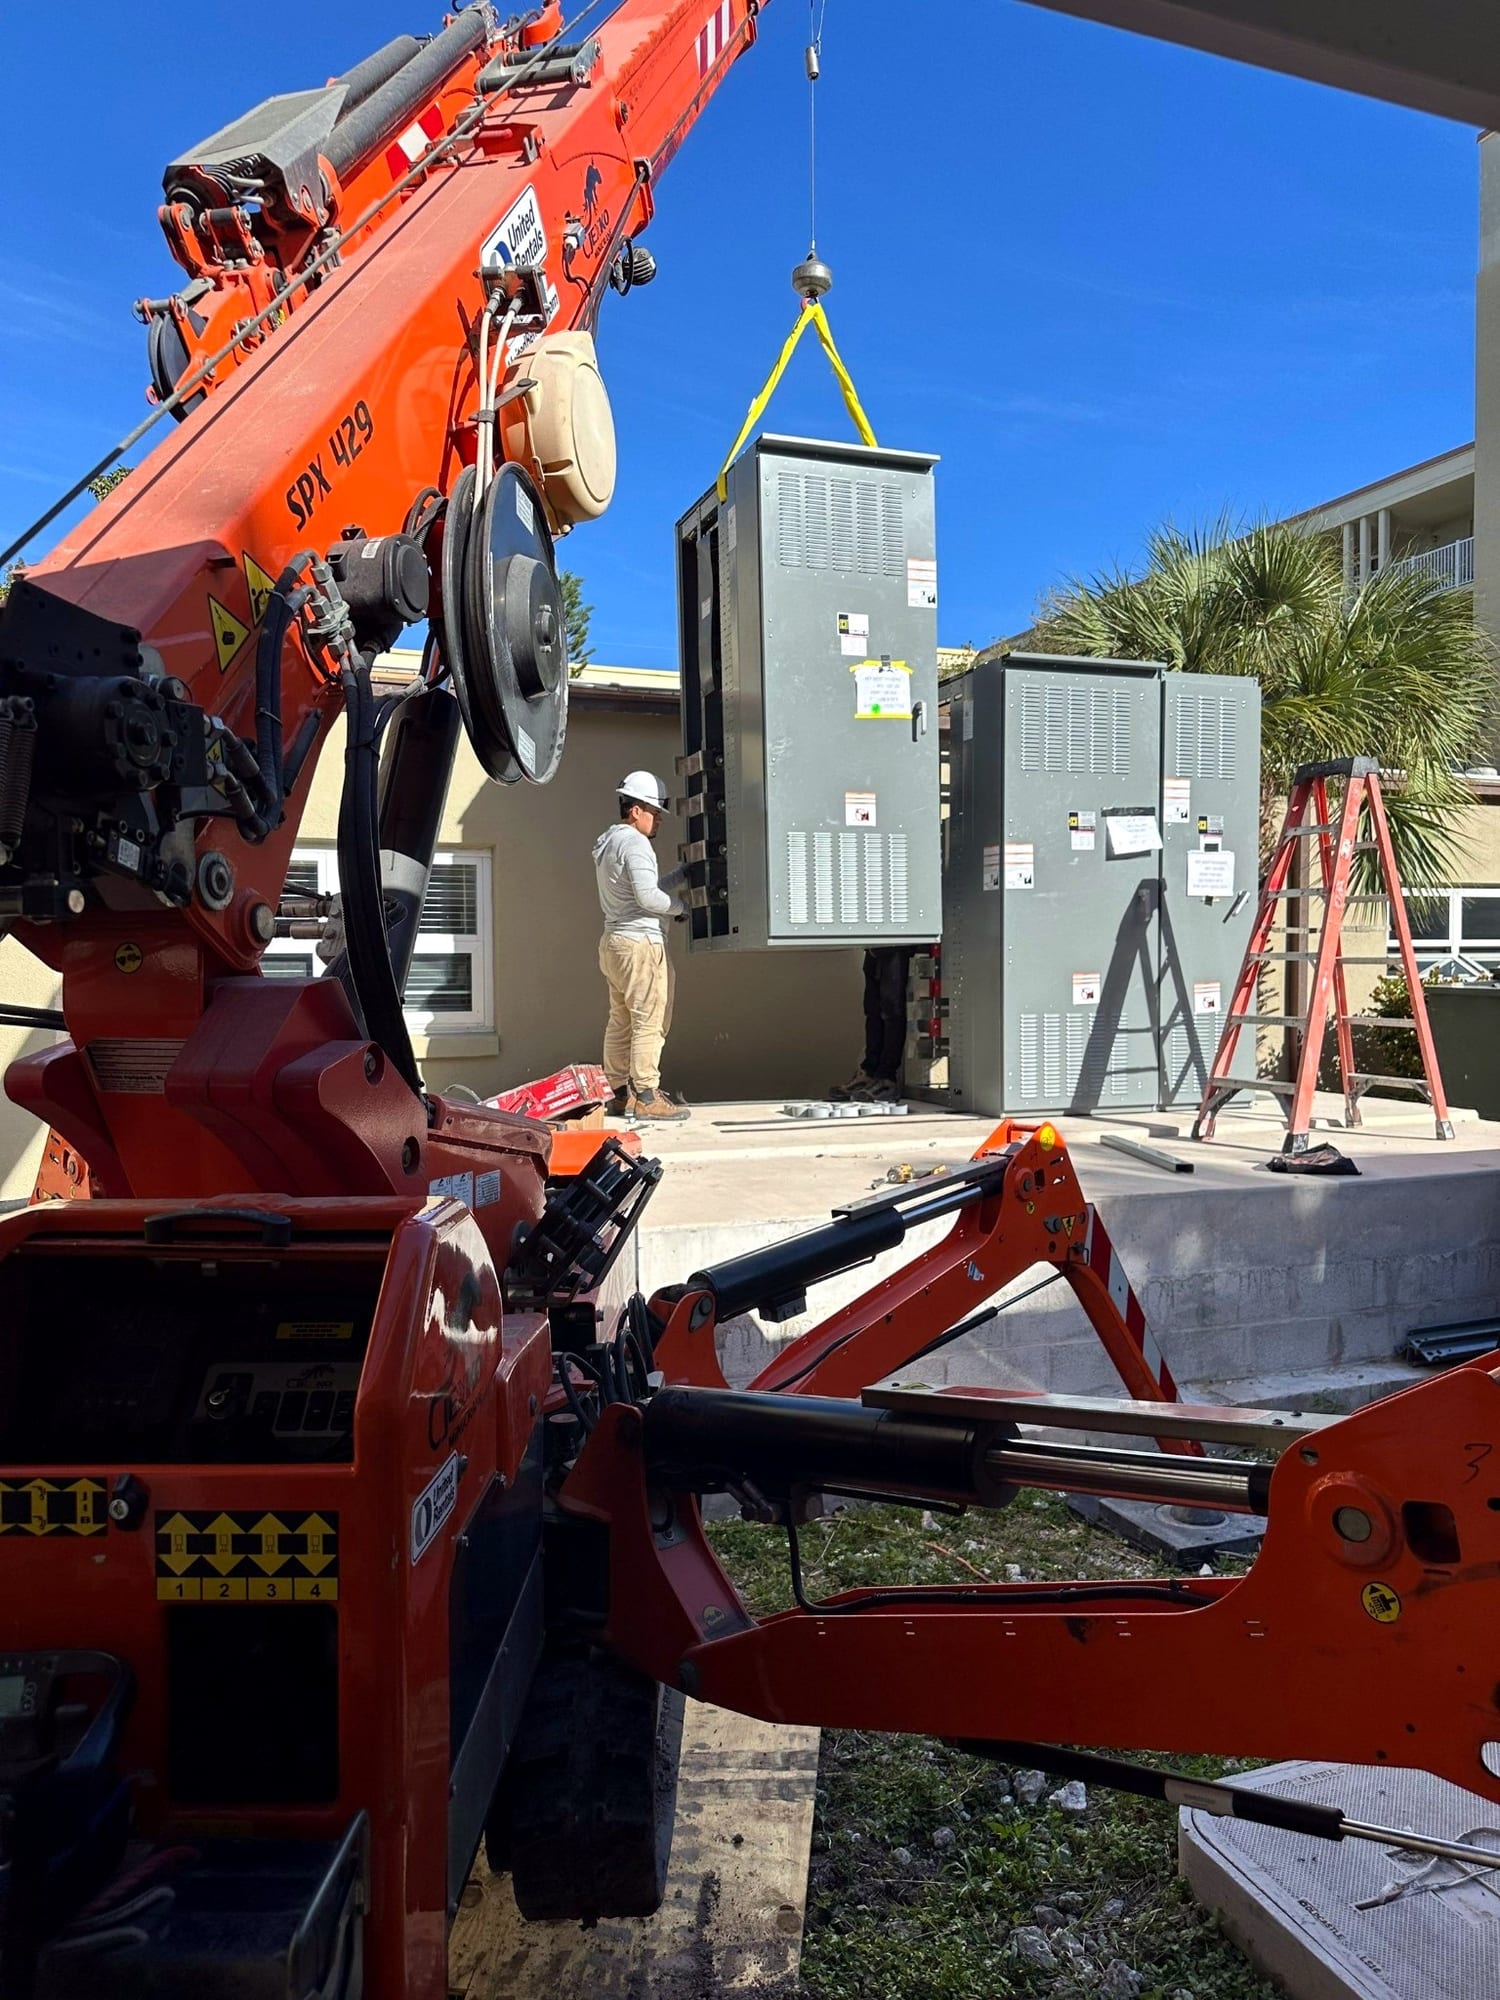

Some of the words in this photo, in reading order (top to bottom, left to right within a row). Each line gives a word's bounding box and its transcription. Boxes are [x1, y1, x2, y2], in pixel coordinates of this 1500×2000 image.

[507, 199, 536, 252] United
[286, 452, 332, 533] SPX
[329, 399, 374, 467] 429
[433, 1464, 454, 1506] United
[1461, 1443, 1493, 1485] 3
[176, 1584, 184, 1597] 1
[219, 1584, 230, 1597] 2
[266, 1584, 277, 1597] 3
[309, 1584, 321, 1597] 4
